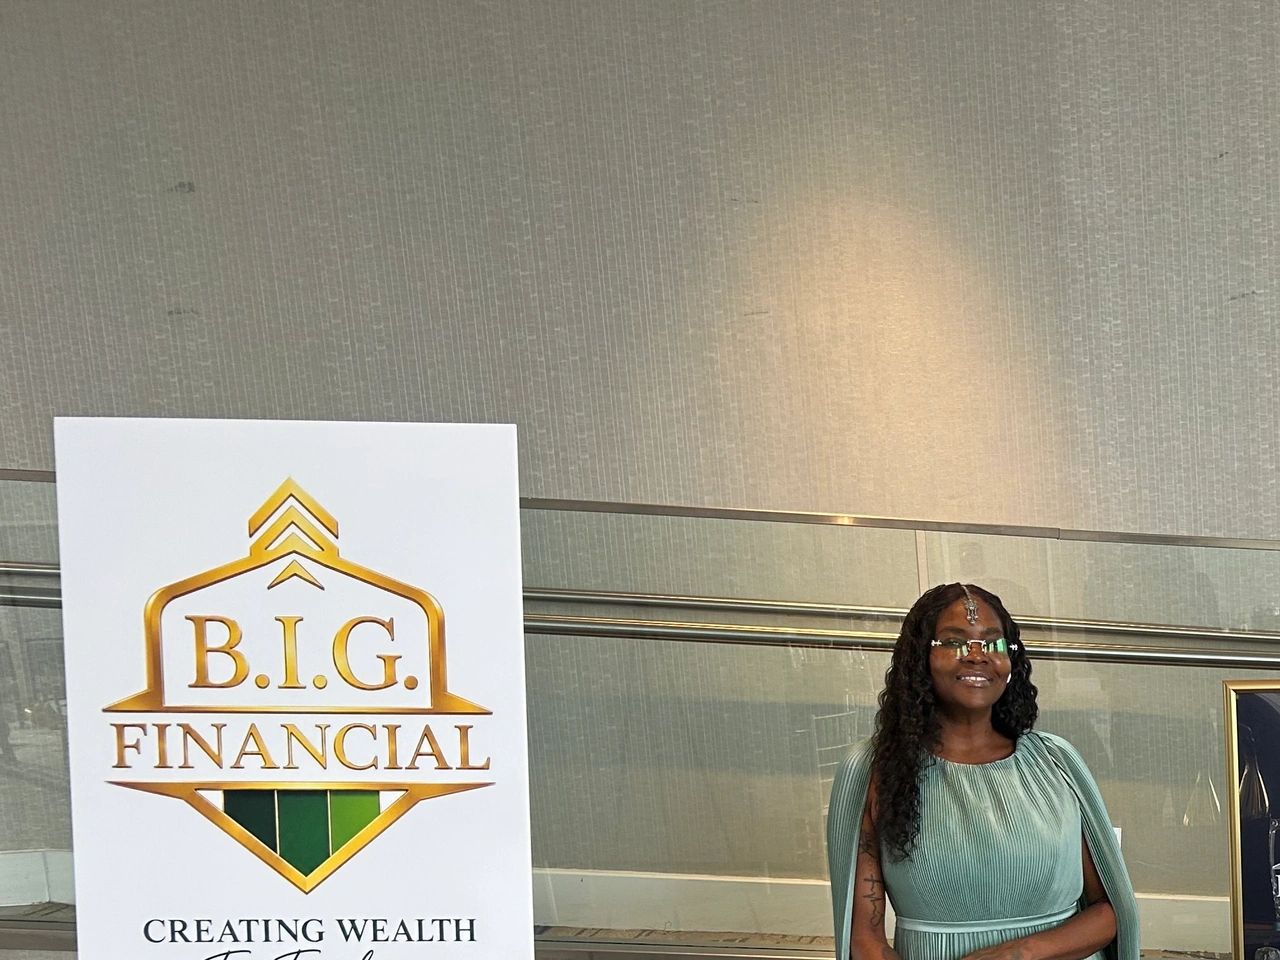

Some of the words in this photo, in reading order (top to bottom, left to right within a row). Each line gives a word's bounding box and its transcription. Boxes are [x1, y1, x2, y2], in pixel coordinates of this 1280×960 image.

[185, 615, 419, 691] B.I.G.
[109, 722, 492, 771] FINANCIAL
[143, 918, 325, 944] CREATING
[337, 918, 477, 943] WEALTH
